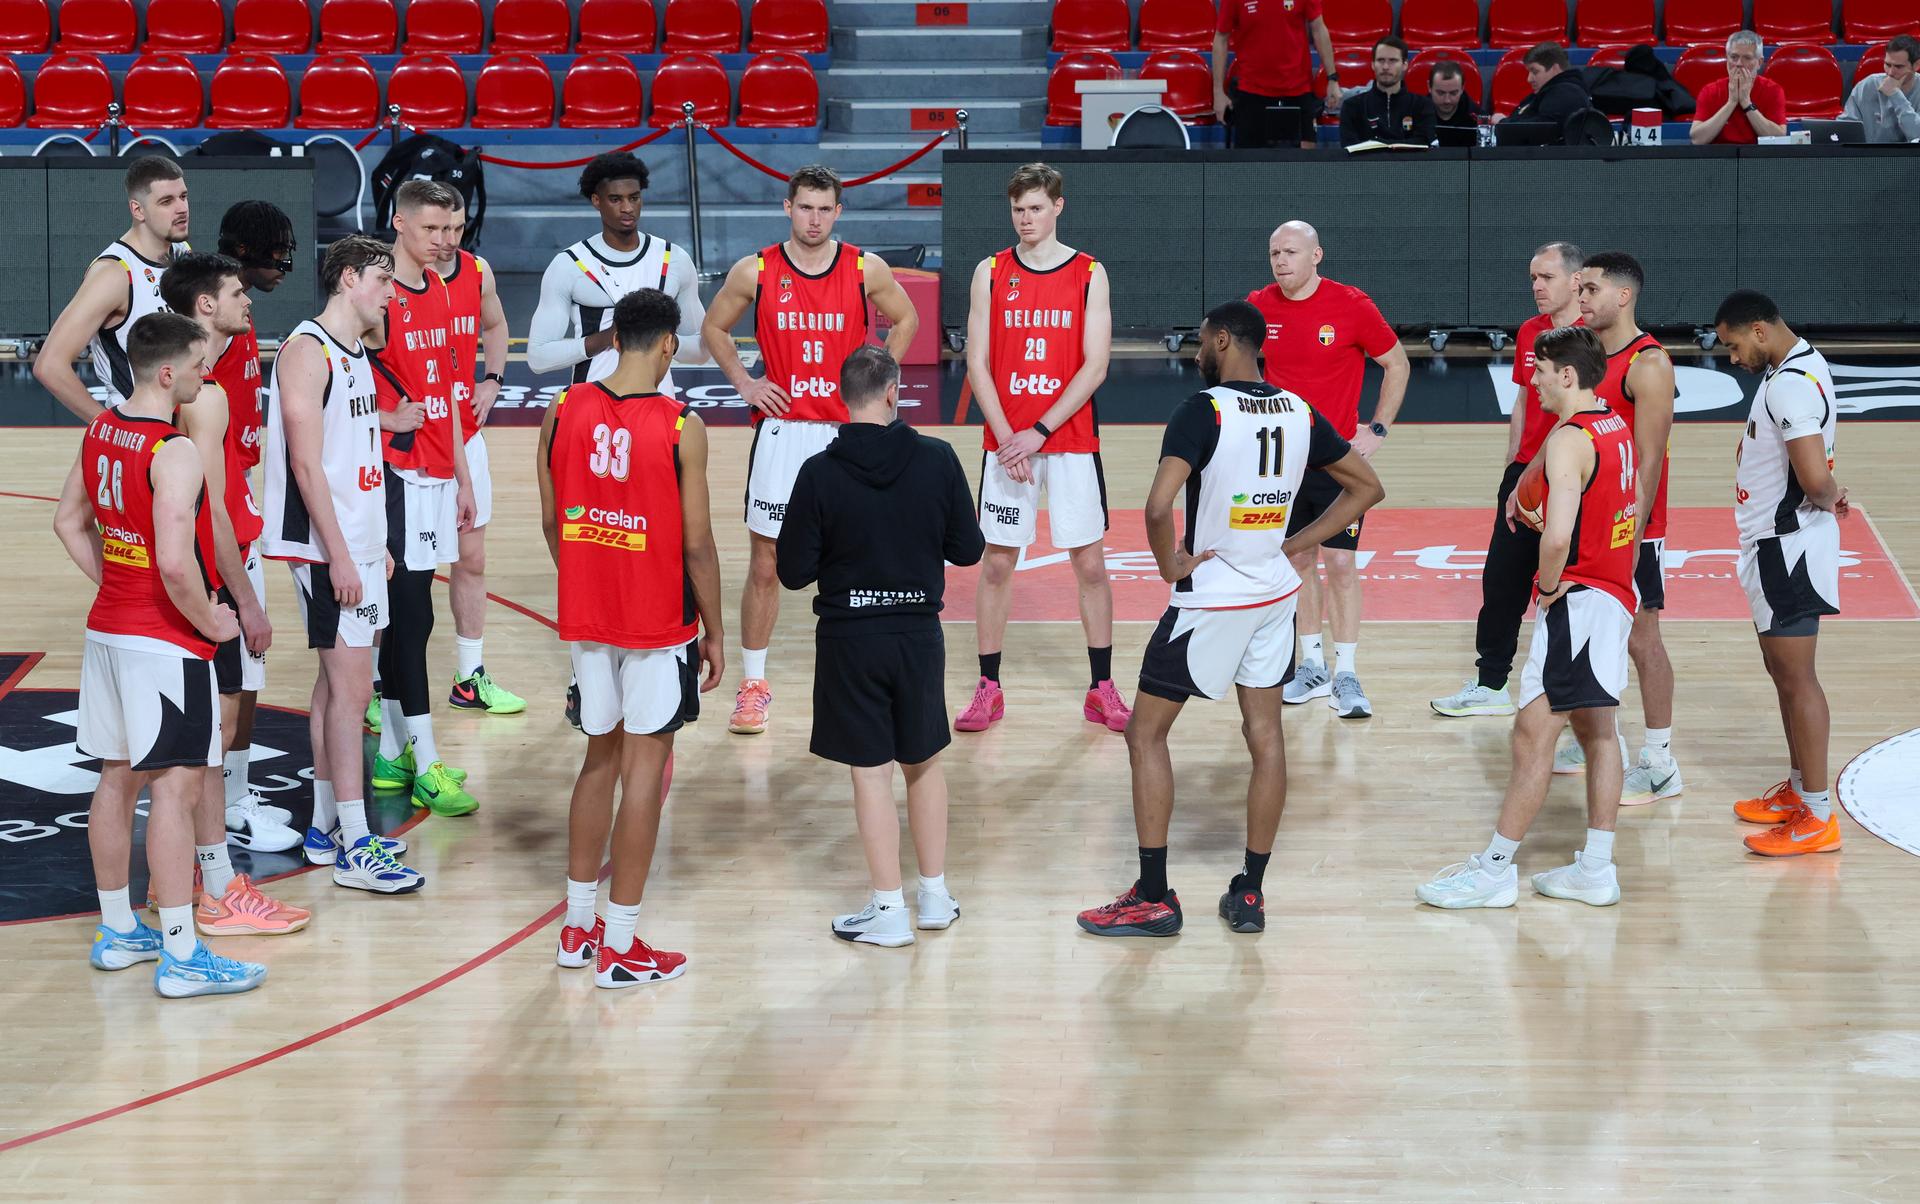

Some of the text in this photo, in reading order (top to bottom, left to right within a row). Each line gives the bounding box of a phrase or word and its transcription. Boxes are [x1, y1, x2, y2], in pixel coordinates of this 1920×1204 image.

[934, 6, 950, 16] 06
[929, 111, 945, 122] 05
[1634, 128, 1642, 141] 4
[1647, 128, 1657, 141] 4
[452, 168, 463, 178] 30
[927, 187, 942, 197] 04
[777, 311, 845, 331] BELGIUM
[1004, 309, 1073, 329] BELGIUM
[802, 340, 824, 364] 35
[1024, 337, 1046, 361] 29
[1236, 396, 1295, 415] SCHWARTZ
[98, 422, 113, 442] DE
[589, 423, 632, 482] 33
[1256, 426, 1284, 477] 11
[769, 511, 785, 521] AD
[984, 501, 1020, 516] POWER
[588, 507, 648, 530] crelan
[997, 515, 1020, 526] ADE
[105, 525, 145, 545] celan
[577, 525, 632, 548] DHL
[849, 589, 926, 599] BASKETBALL
[199, 852, 216, 861] 23
